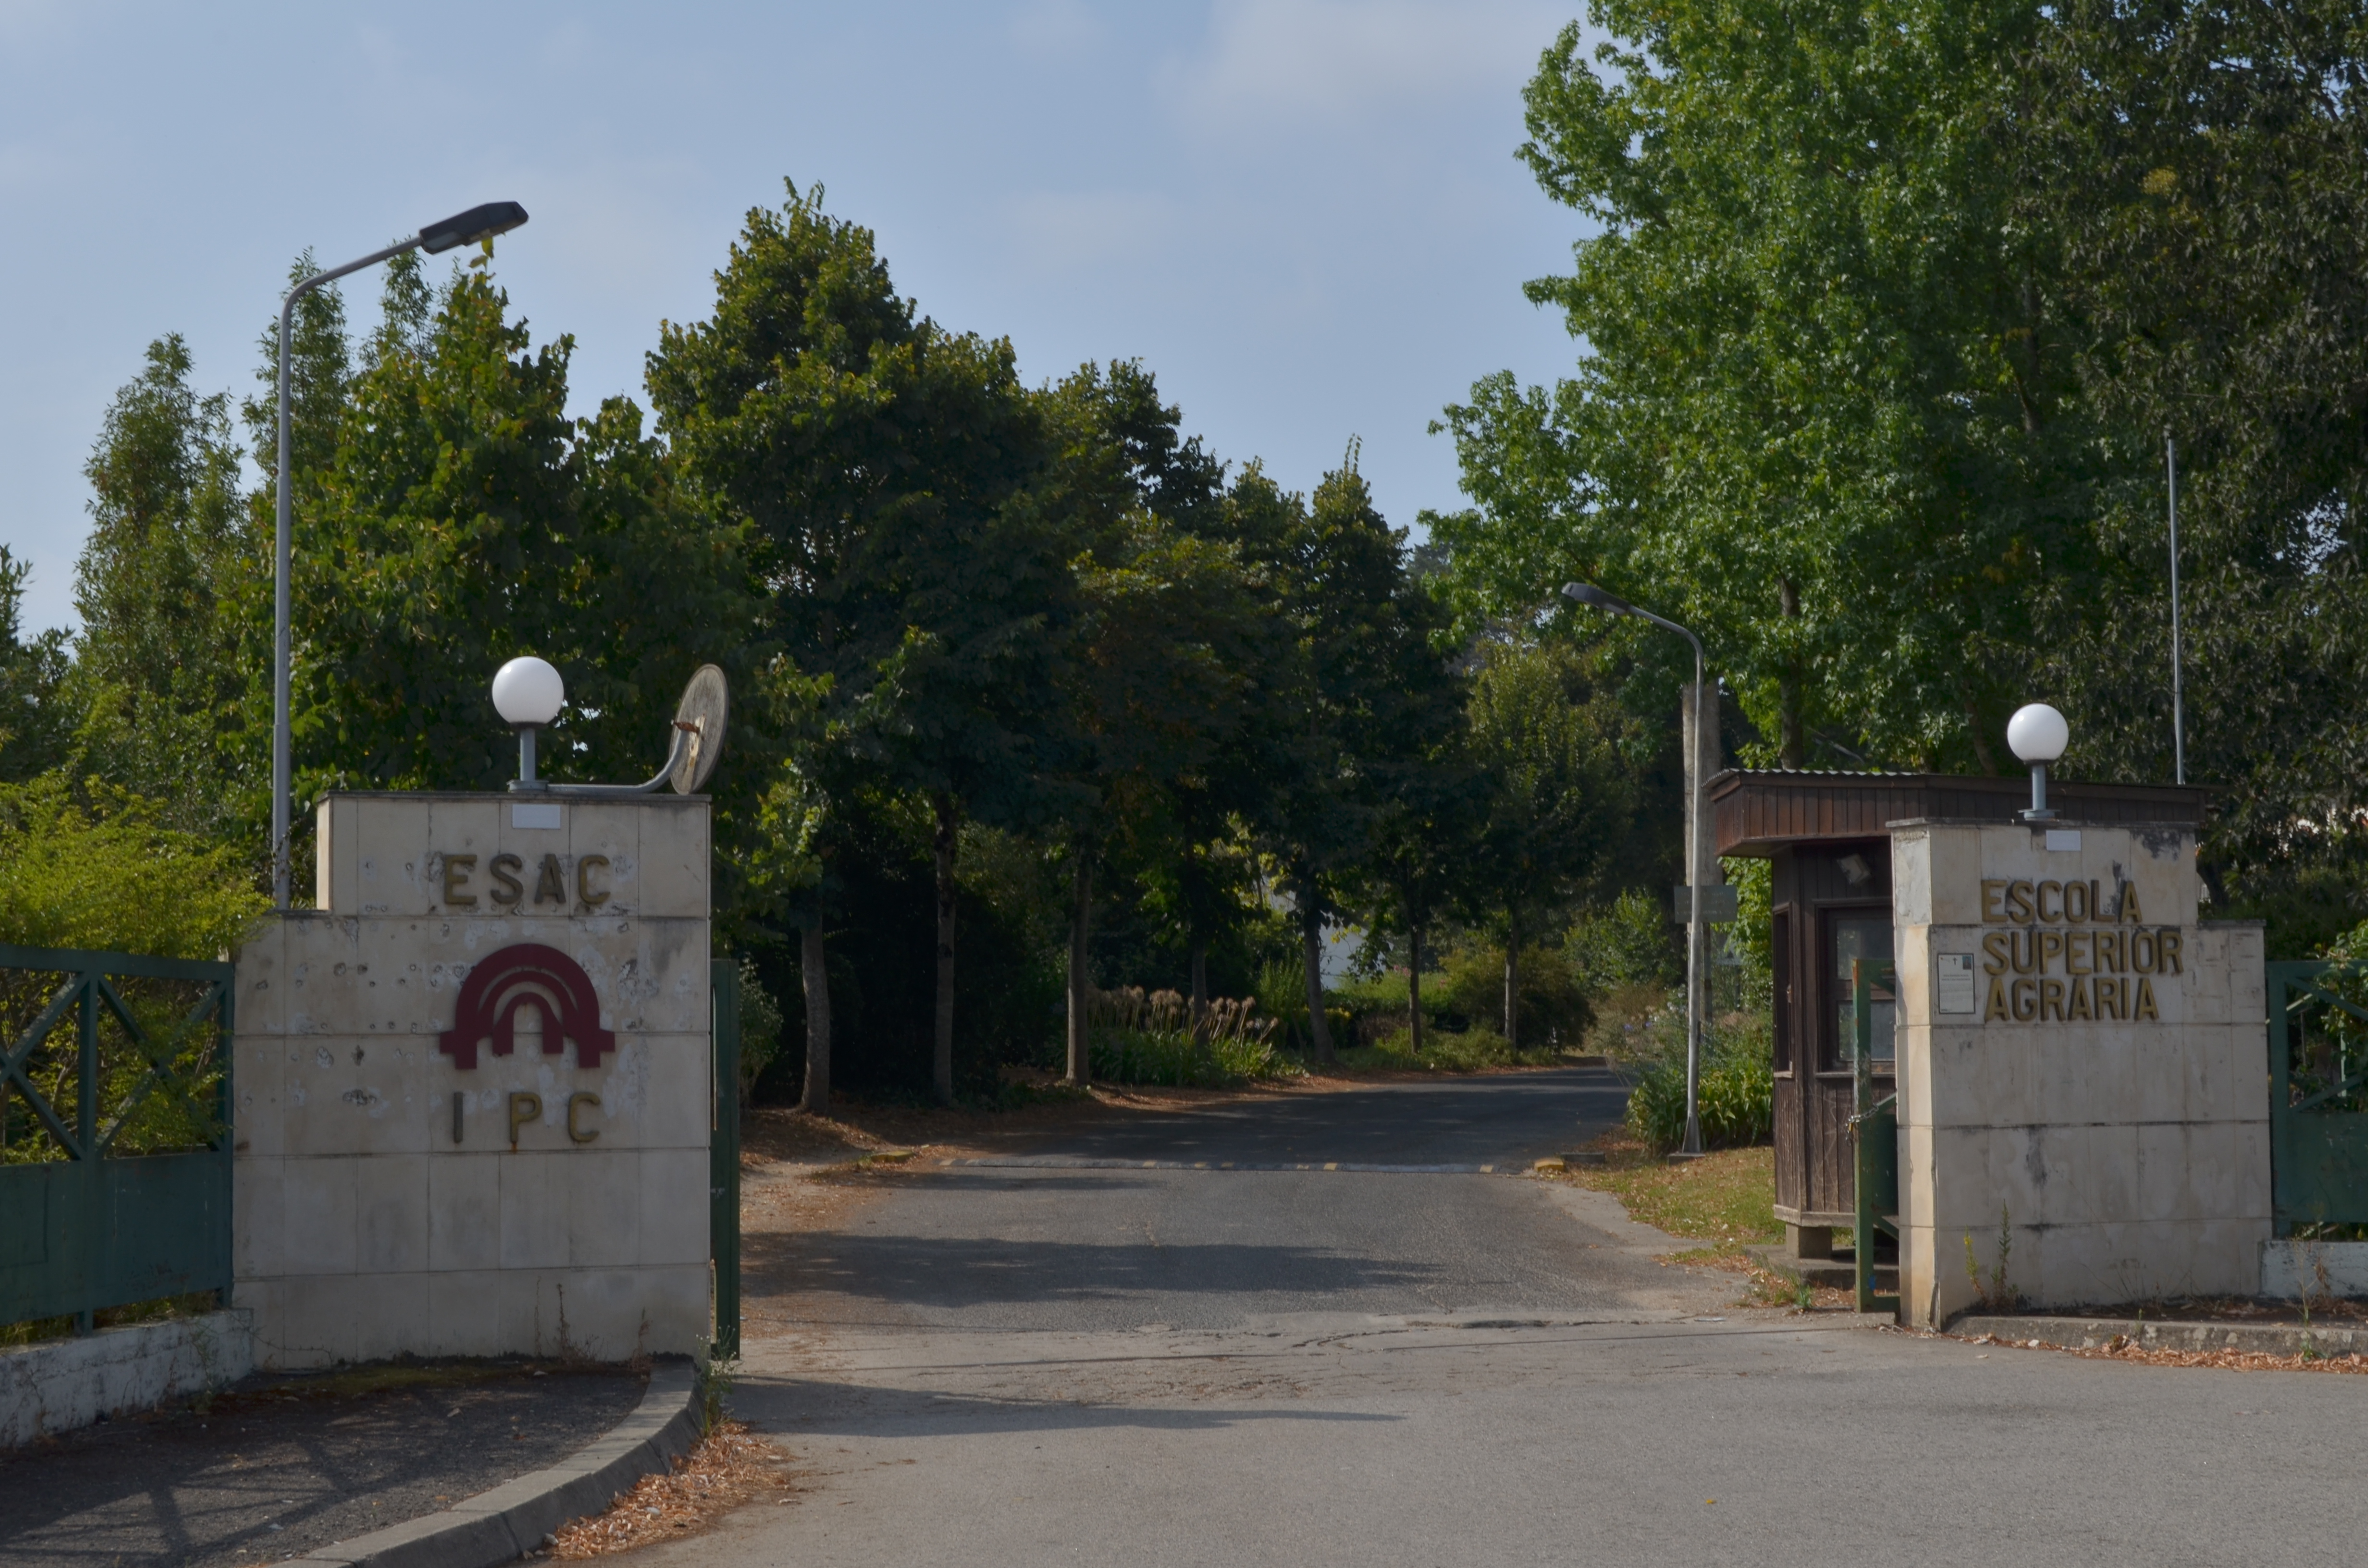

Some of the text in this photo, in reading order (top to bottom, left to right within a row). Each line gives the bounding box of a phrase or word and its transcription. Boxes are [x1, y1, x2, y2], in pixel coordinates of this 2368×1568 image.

[444, 854, 610, 904] ESAC
[1981, 880, 2142, 923] ESCOLA
[1983, 931, 2183, 975] SUPERIOR
[1984, 978, 2159, 1023] AGRARIA
[453, 1092, 600, 1143] IPC
